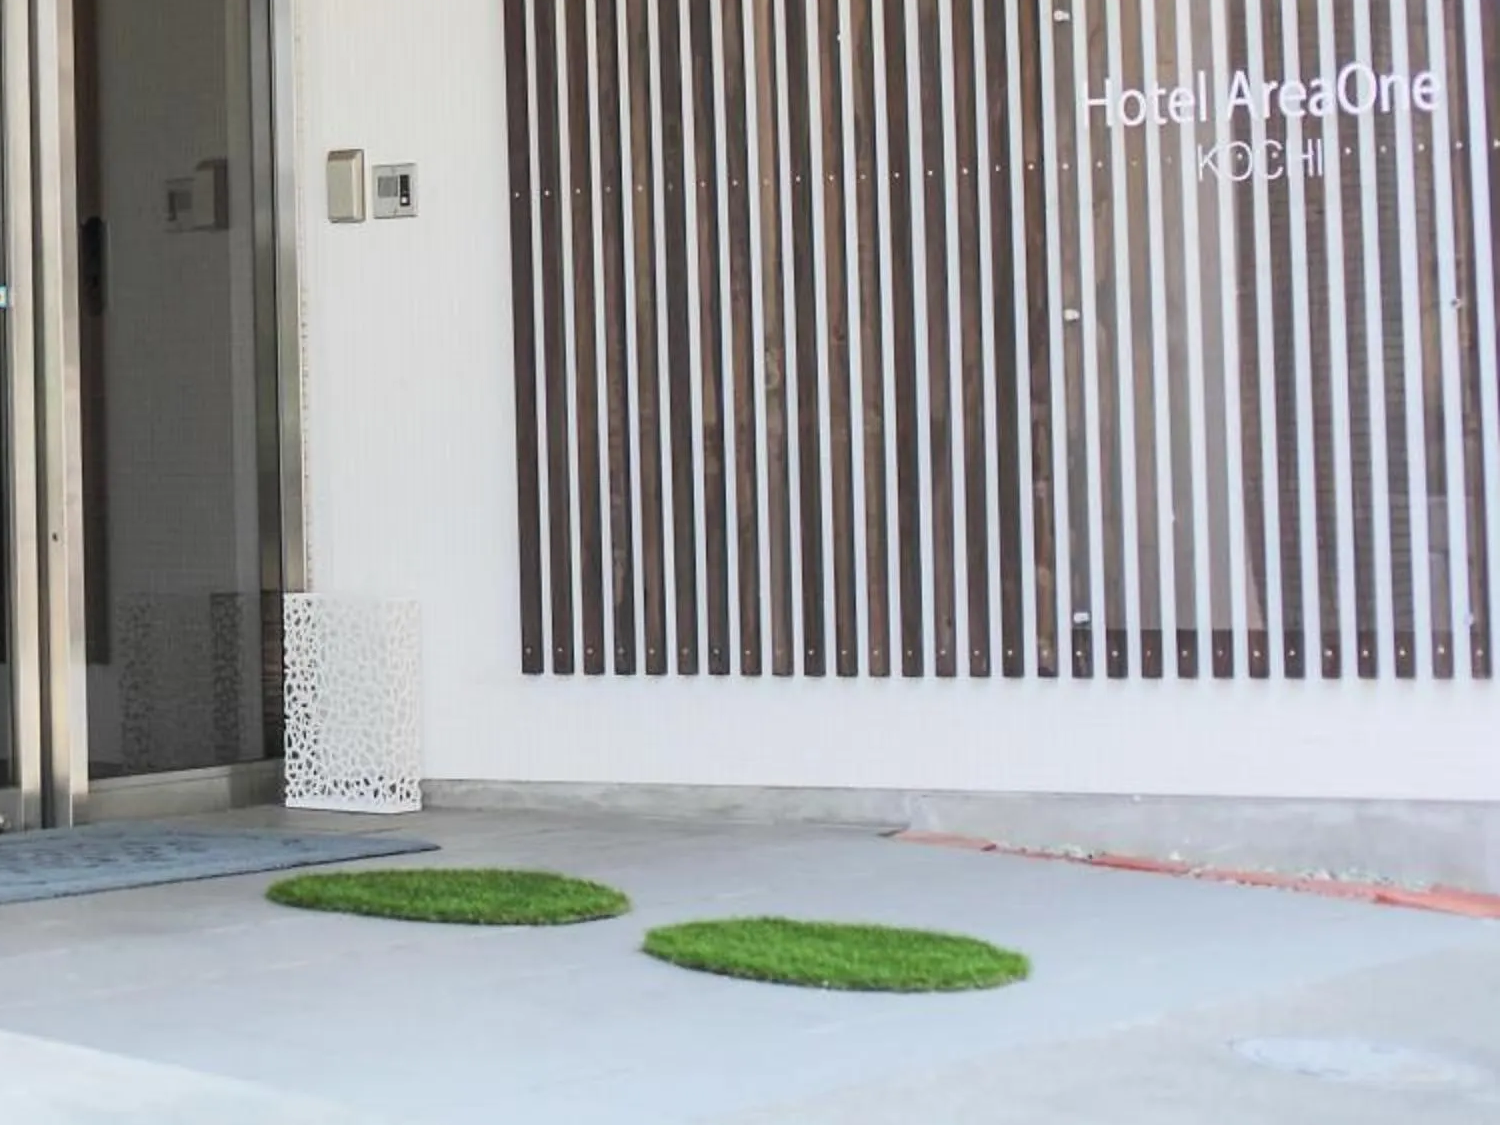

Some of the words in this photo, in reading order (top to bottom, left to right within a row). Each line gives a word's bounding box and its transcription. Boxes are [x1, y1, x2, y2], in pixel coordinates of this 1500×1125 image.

[1082, 70, 1207, 128] Hotel
[1227, 61, 1443, 121] AreaOne
[1197, 137, 1325, 182] KOCHI
